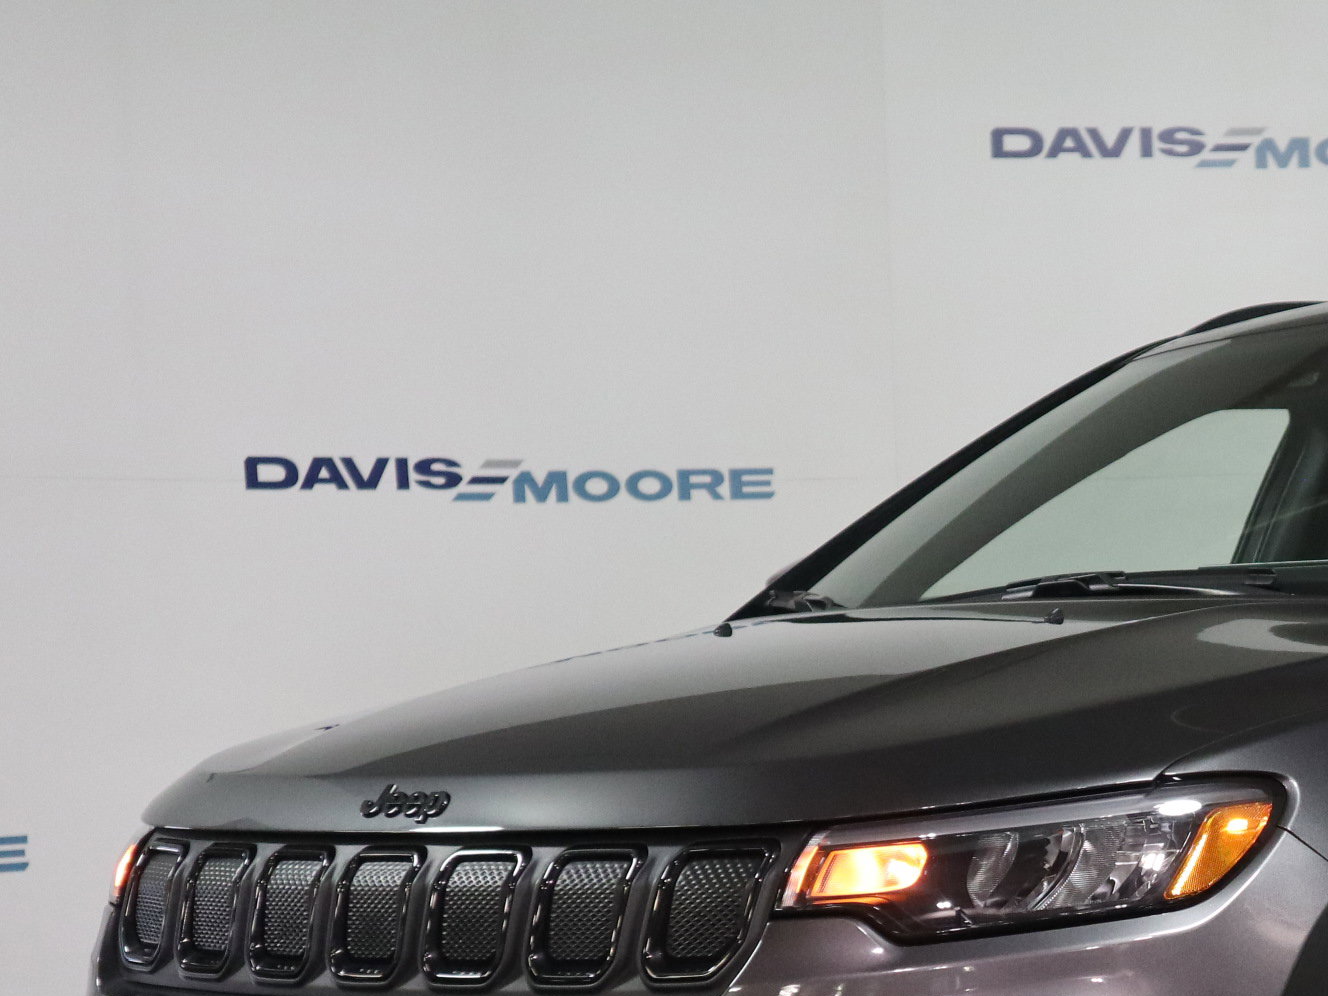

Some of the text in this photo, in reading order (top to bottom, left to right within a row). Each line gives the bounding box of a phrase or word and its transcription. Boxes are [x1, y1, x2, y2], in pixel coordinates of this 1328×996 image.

[990, 126, 1207, 160] DAVIS
[244, 456, 776, 504] DAVIS MOORE
[360, 783, 452, 824] Jeep
